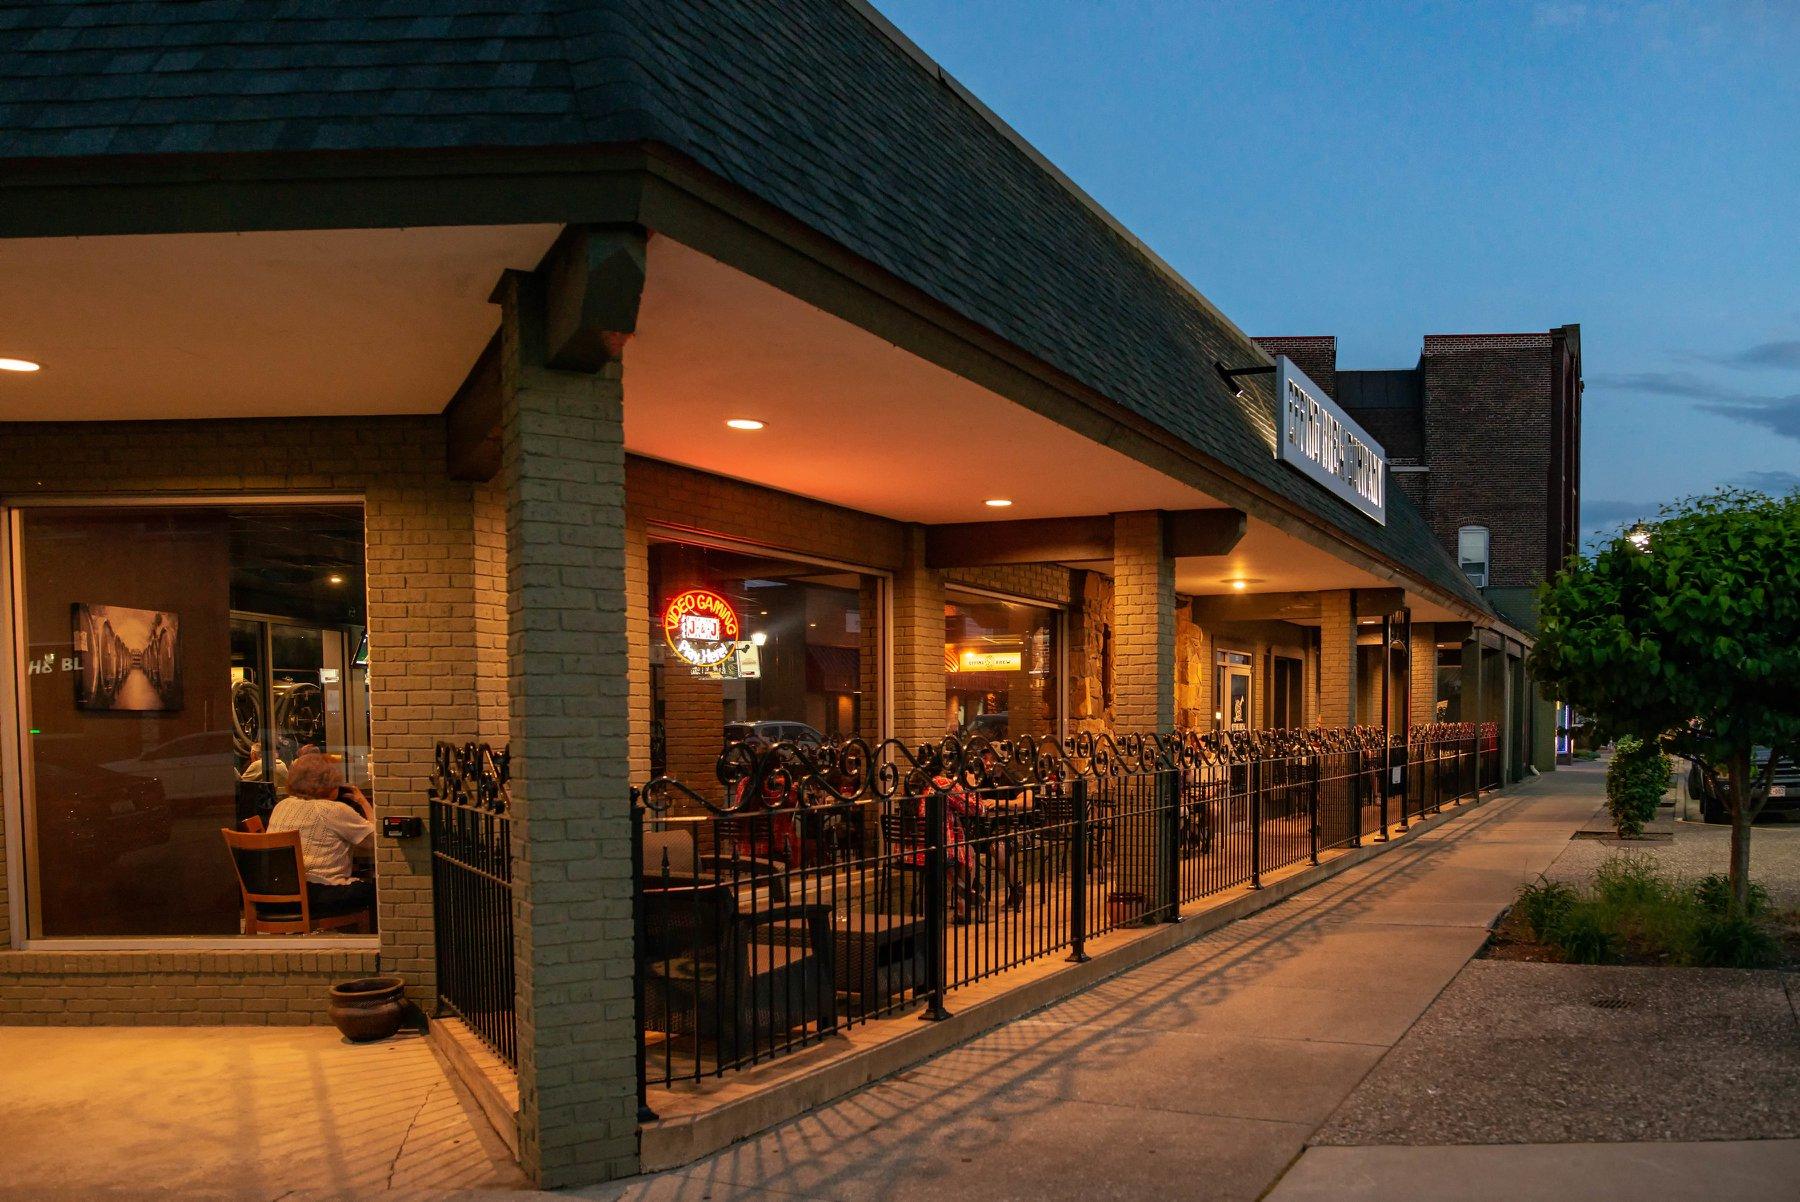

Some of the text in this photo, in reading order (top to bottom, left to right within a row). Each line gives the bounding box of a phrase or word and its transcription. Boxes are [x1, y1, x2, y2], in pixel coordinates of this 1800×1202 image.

[667, 594, 737, 635] VIDEO GAMING
[689, 620, 696, 635] J
[710, 622, 717, 637] J
